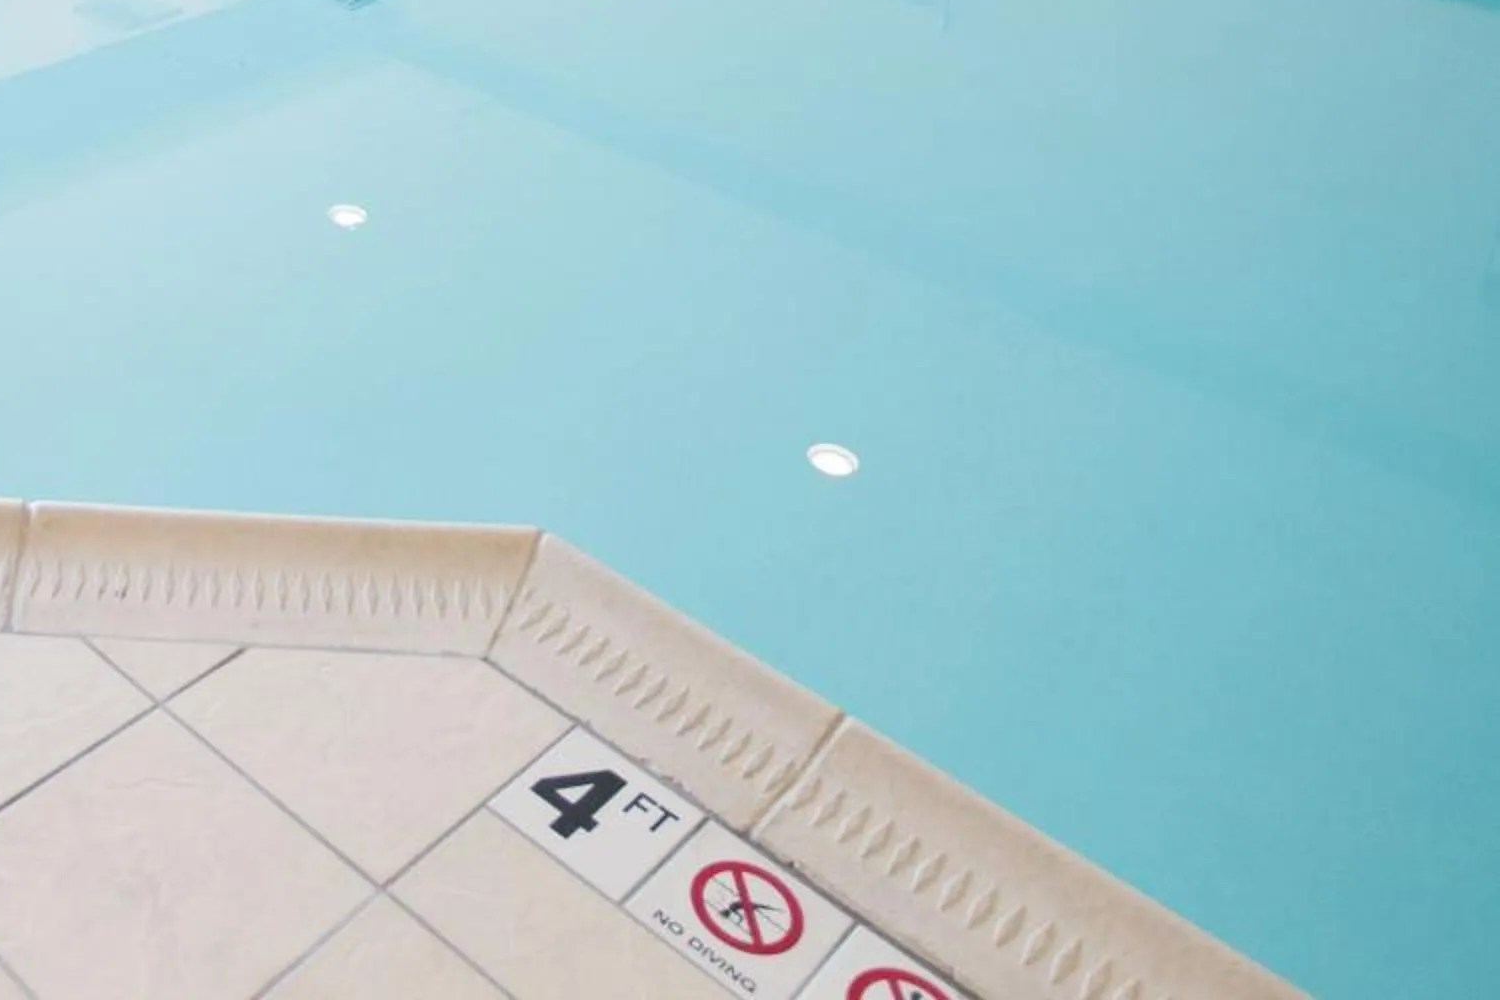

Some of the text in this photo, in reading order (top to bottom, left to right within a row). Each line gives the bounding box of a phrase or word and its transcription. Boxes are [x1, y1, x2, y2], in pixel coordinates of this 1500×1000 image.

[530, 769, 681, 839] 4 FT
[652, 908, 758, 994] NO DIVING
